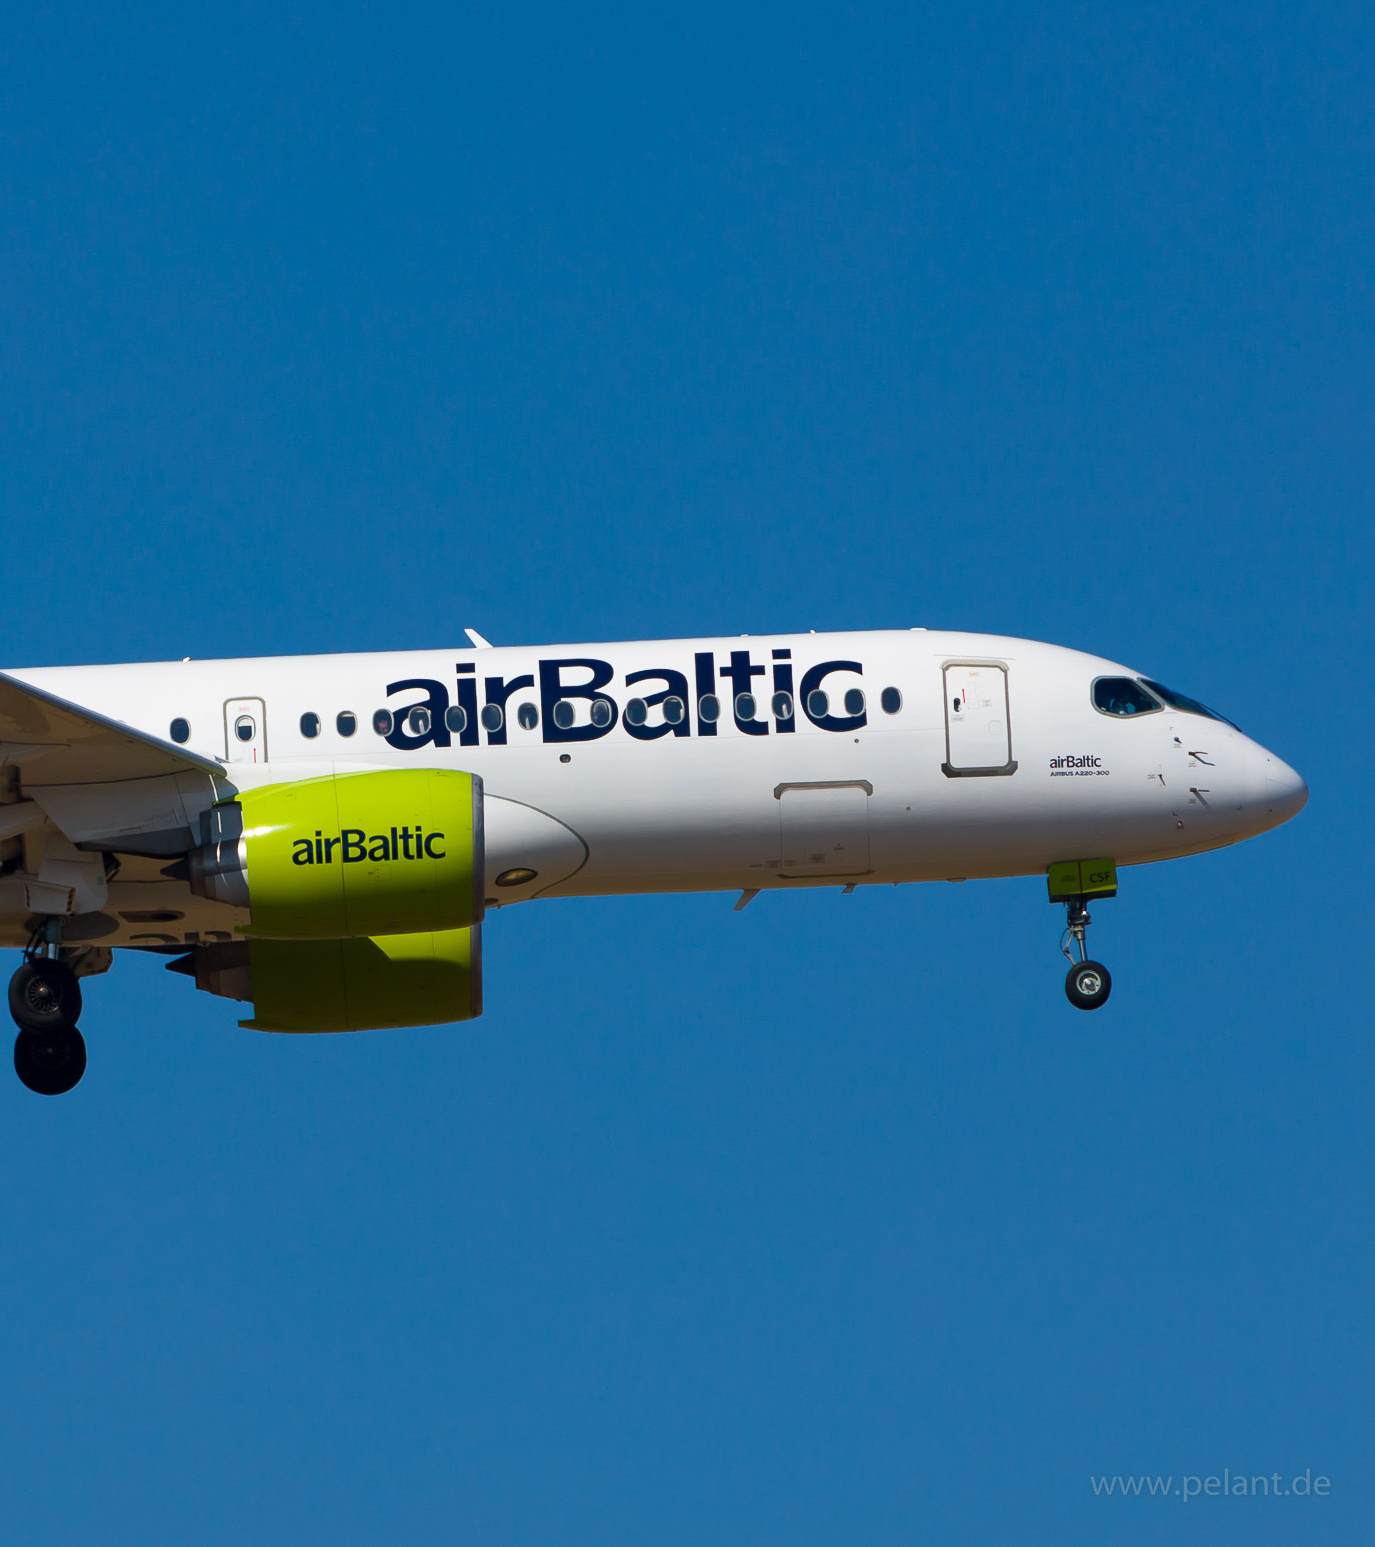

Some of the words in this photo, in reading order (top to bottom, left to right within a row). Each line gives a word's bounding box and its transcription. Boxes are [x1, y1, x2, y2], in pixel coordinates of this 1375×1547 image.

[385, 648, 868, 751] airBaltic
[1049, 755, 1102, 769] airBaltic
[292, 825, 446, 866] airBaltic
[1089, 871, 1111, 883] CSF
